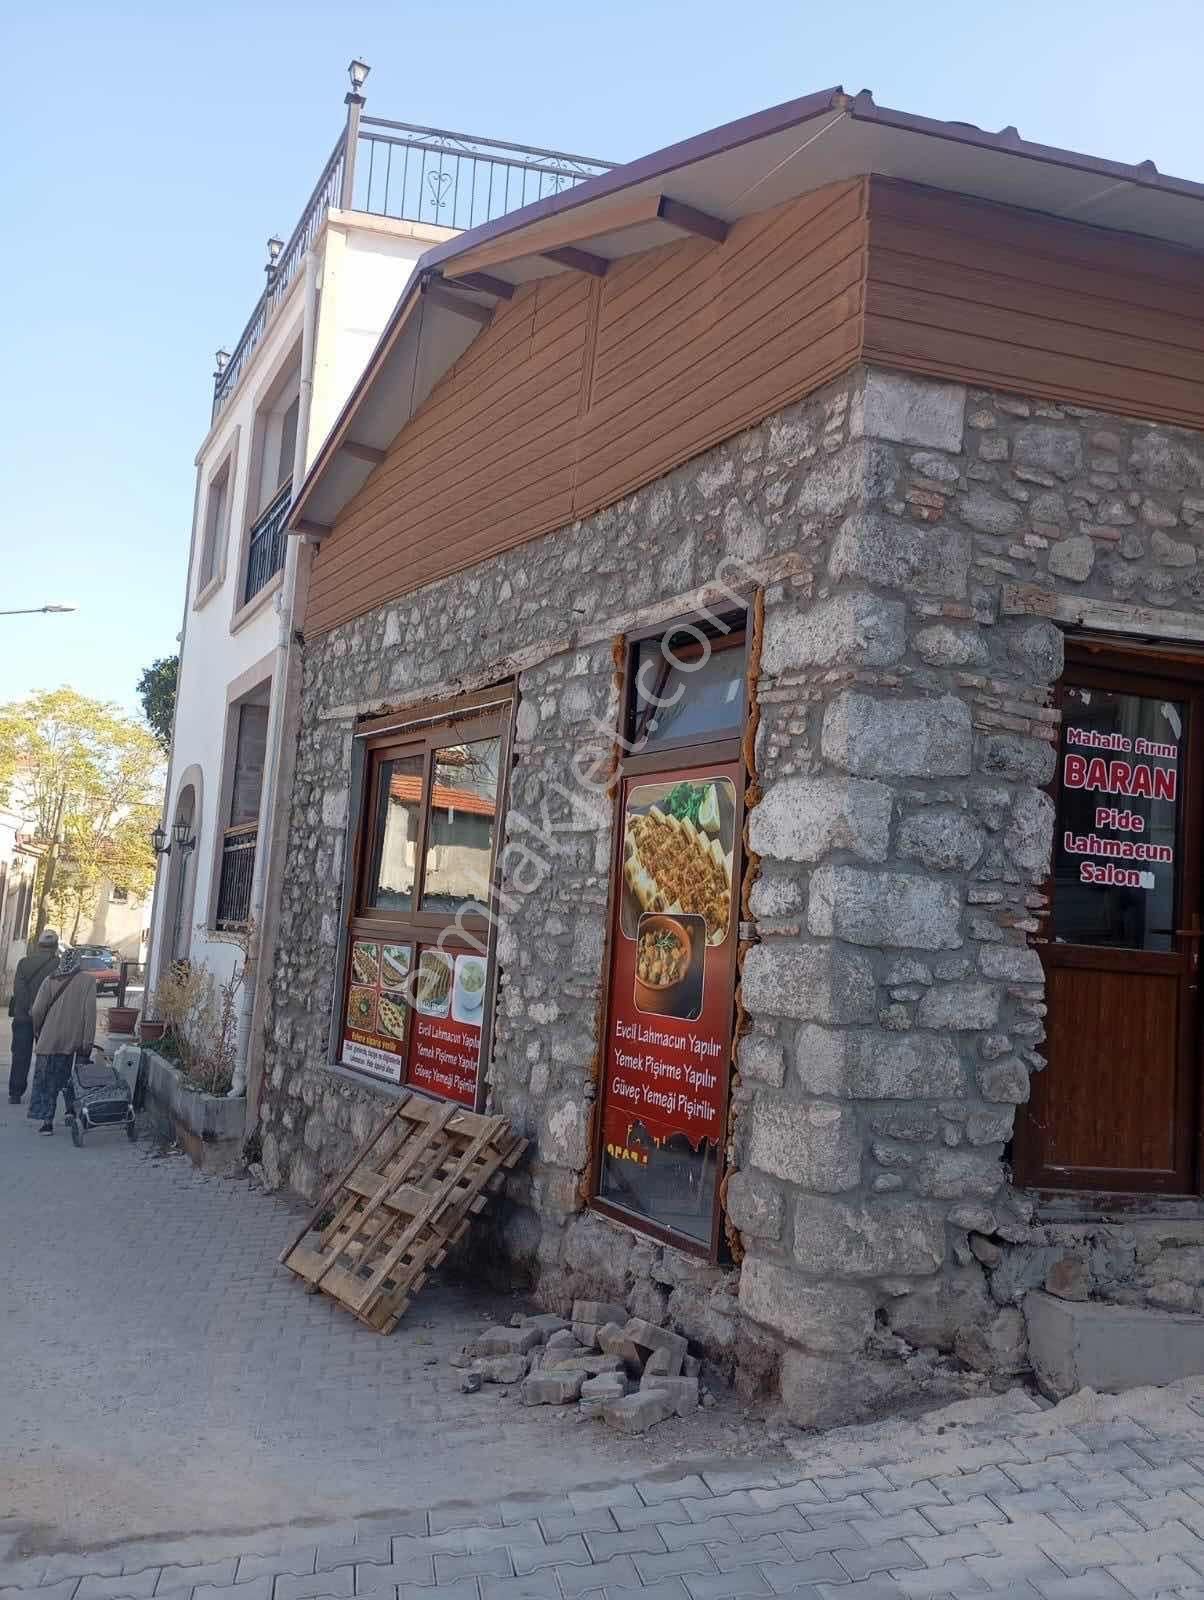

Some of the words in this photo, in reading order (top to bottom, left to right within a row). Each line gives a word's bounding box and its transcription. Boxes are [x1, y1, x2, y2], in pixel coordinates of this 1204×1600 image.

[1067, 727, 1132, 752] Mahalle
[1064, 753, 1176, 801] BARAN
[1095, 807, 1144, 832] Pide
[1064, 832, 1173, 863] Lahmacun
[616, 1021, 636, 1040] Evcil
[638, 1025, 686, 1050] Lahmacun
[689, 1033, 721, 1061] Yapılır
[615, 1048, 643, 1071] Yemek
[645, 1056, 681, 1080] Pişirme
[684, 1064, 717, 1091] Yapılır
[613, 1077, 641, 1104] Güveç
[642, 1084, 676, 1113] Yemeği
[678, 1094, 716, 1120] Pişirilir
